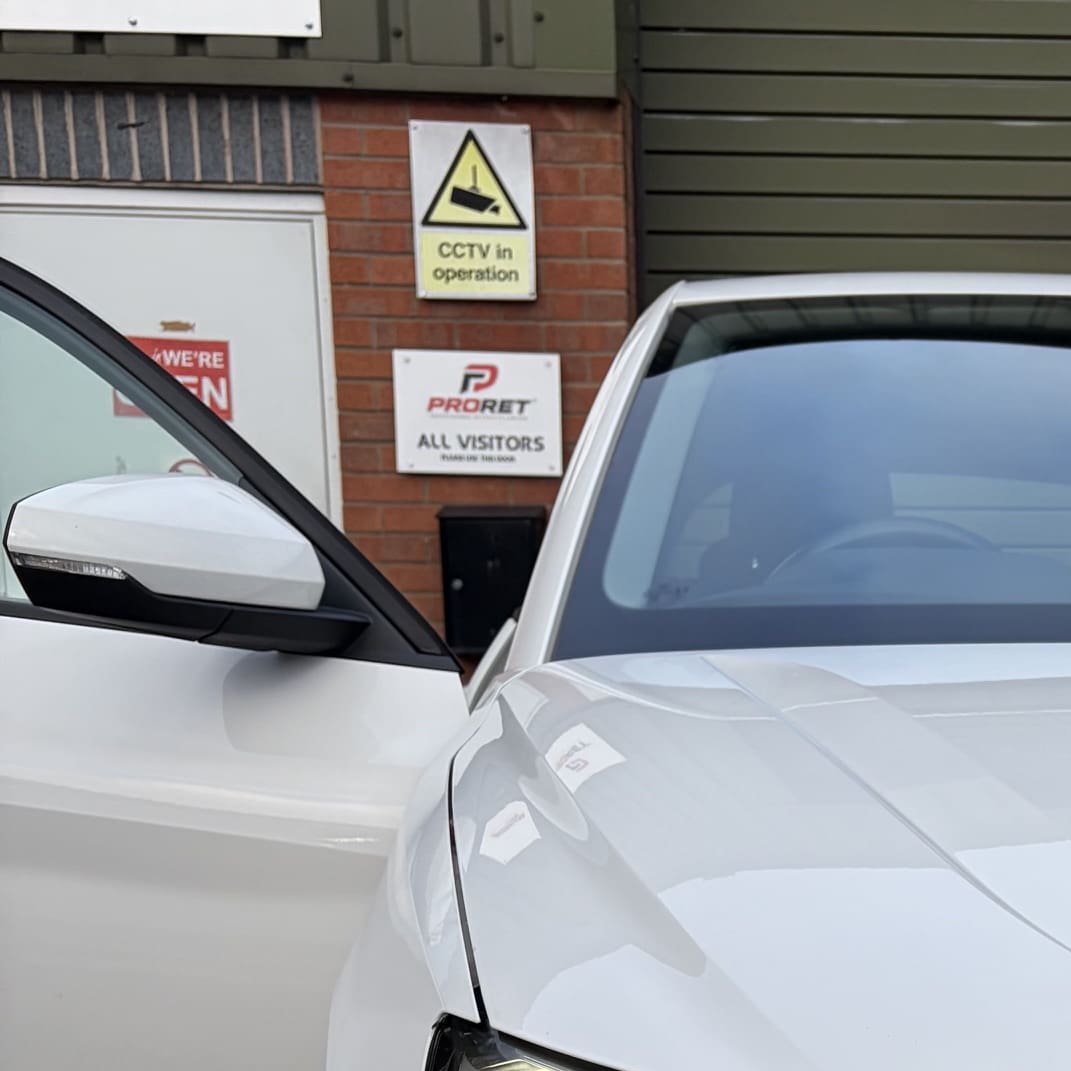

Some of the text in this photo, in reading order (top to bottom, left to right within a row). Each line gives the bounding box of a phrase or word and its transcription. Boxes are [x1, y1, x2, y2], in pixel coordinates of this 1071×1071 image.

[437, 242, 513, 260] CCTV in
[432, 266, 520, 285] operation
[161, 349, 225, 369] WE'RE
[427, 397, 533, 414] PRORET
[417, 433, 546, 452] ALL VISITORS
